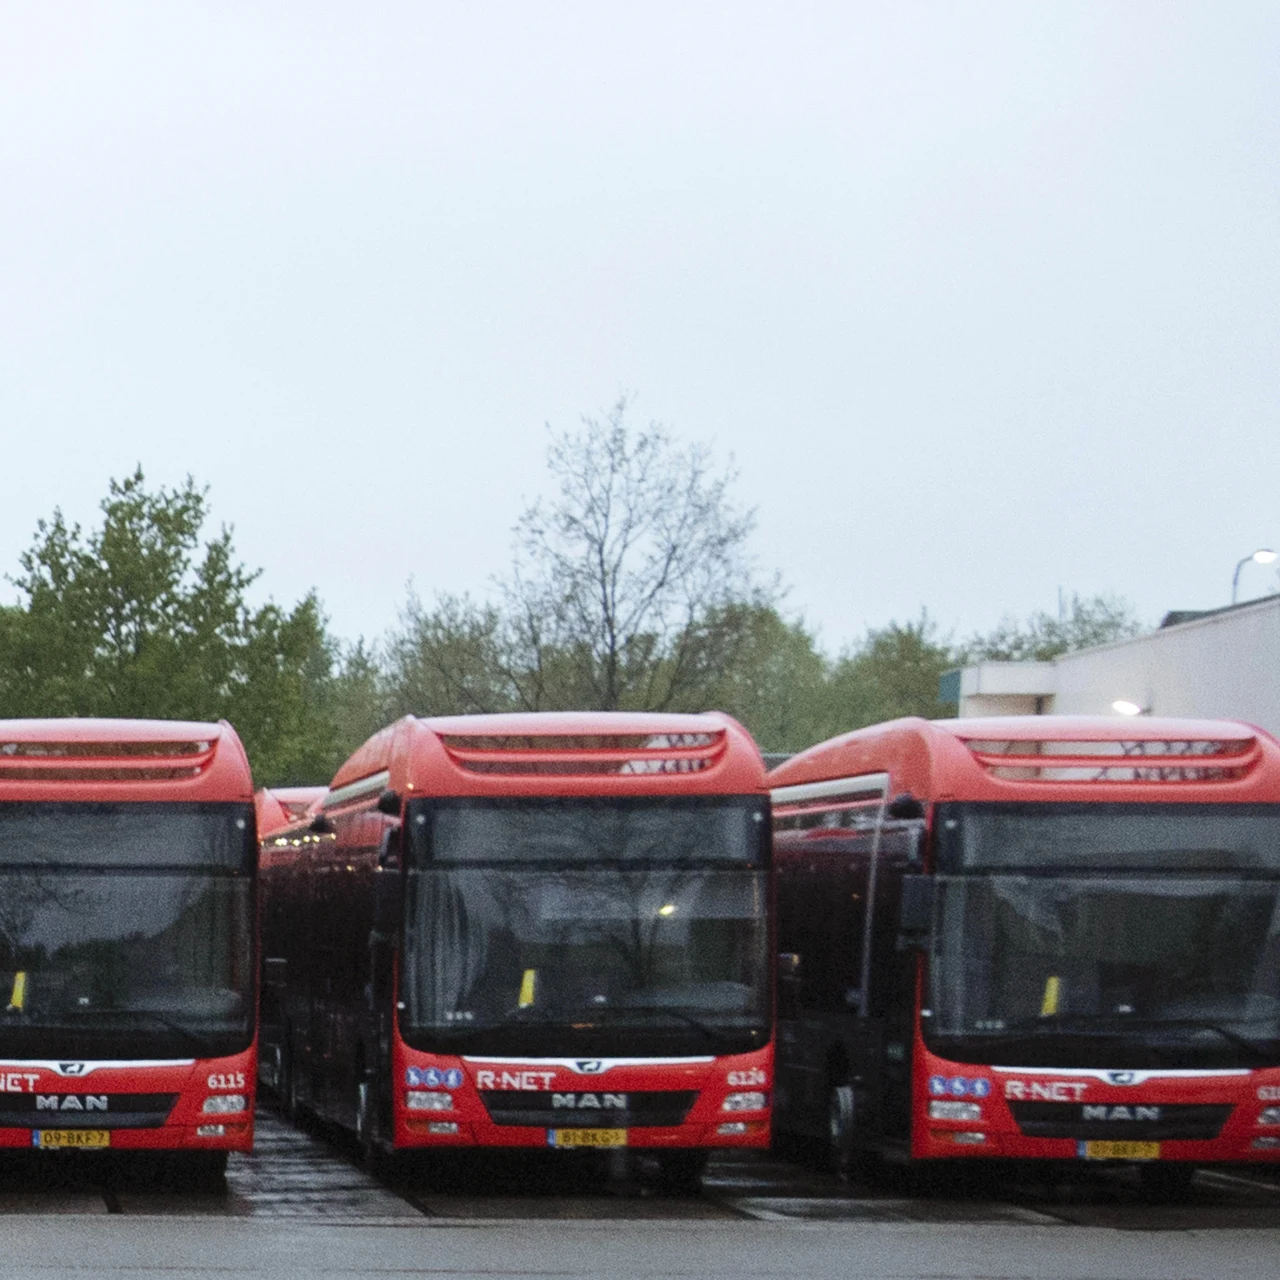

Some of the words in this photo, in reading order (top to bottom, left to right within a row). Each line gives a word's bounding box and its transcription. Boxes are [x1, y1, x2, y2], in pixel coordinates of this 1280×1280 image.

[207, 1073, 246, 1089] 6115
[36, 1095, 109, 1111] MAN
[551, 1093, 628, 1109] MAN
[1081, 1105, 1160, 1121] MAN
